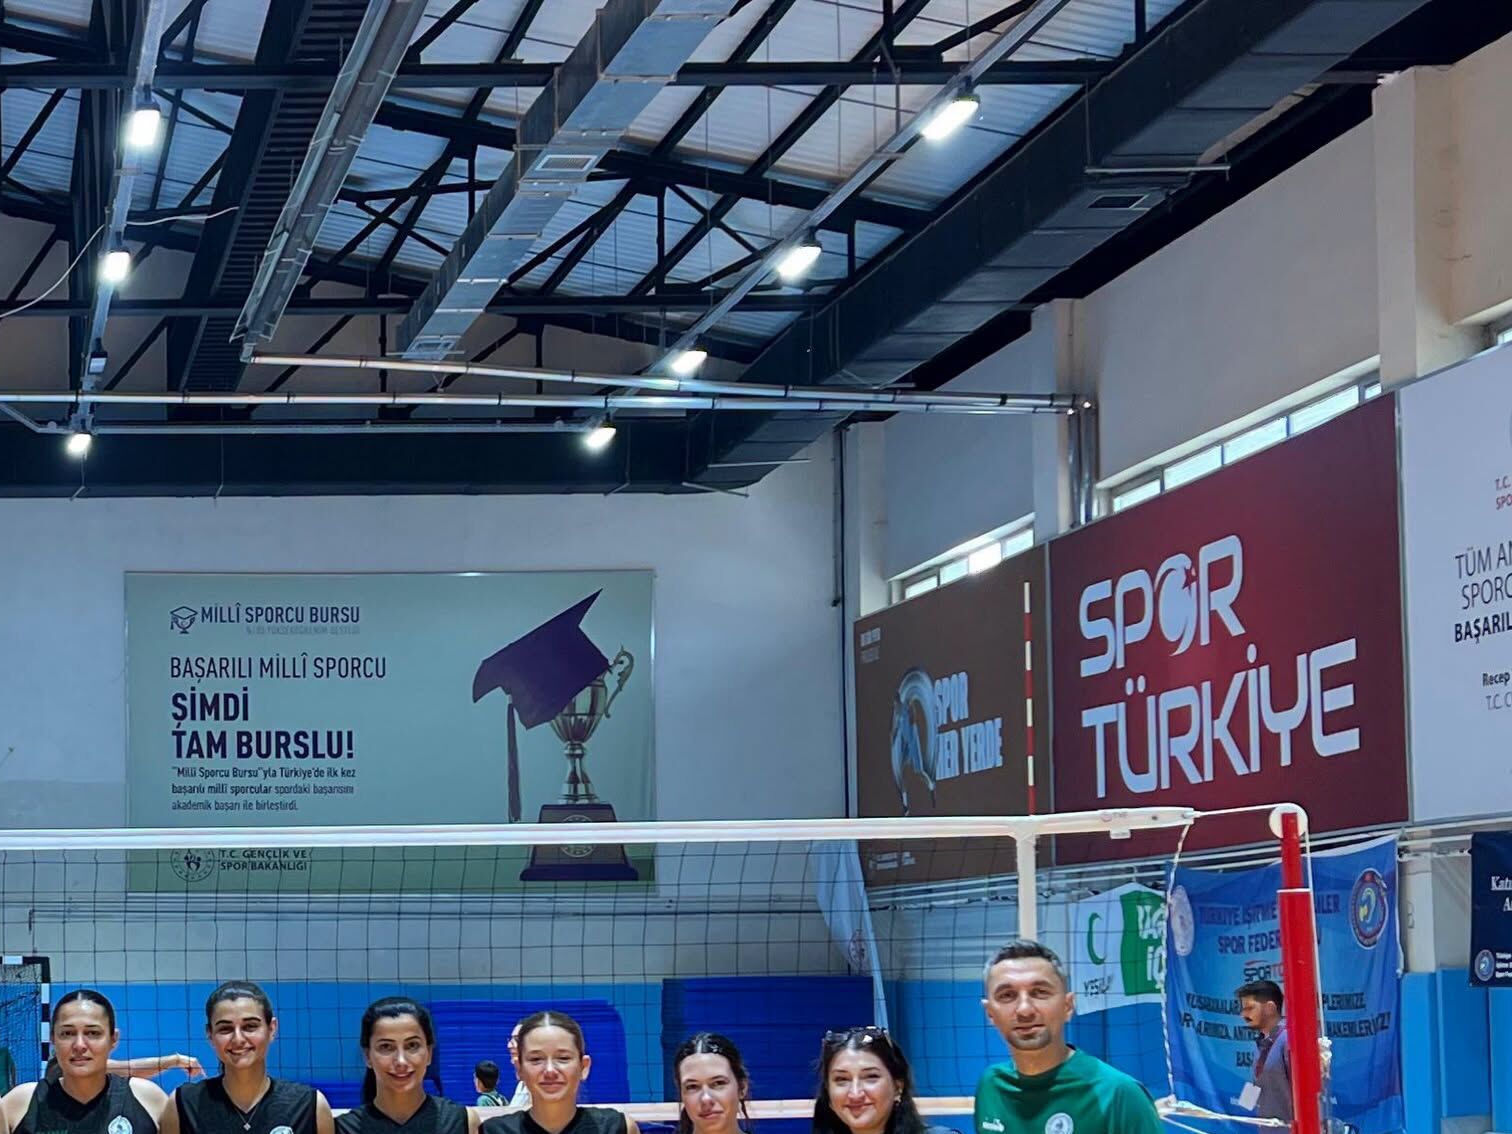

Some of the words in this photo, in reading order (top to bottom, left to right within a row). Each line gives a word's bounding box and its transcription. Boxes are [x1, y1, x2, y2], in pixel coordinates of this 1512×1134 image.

[1455, 547, 1492, 579] TÜM
[201, 602, 241, 623] MİLLÎ
[245, 606, 305, 623] SPORCU
[309, 606, 360, 623] BURSU
[1080, 534, 1246, 677] SPOR
[170, 657, 252, 683] BAŞARILI
[260, 652, 308, 679] MİLLÎ
[313, 657, 386, 679] SPORCU
[172, 686, 249, 729] ŞİMDİ
[935, 671, 968, 727] SPOR
[1080, 638, 1360, 799] TÜRKİYE
[172, 730, 227, 759] TAM
[236, 730, 355, 759] BURSLU!
[199, 767, 230, 781] Sporcu
[341, 767, 356, 778] kez
[230, 784, 272, 796] sporcular
[293, 850, 307, 859] VE
[1218, 936, 1245, 953] SPOR
